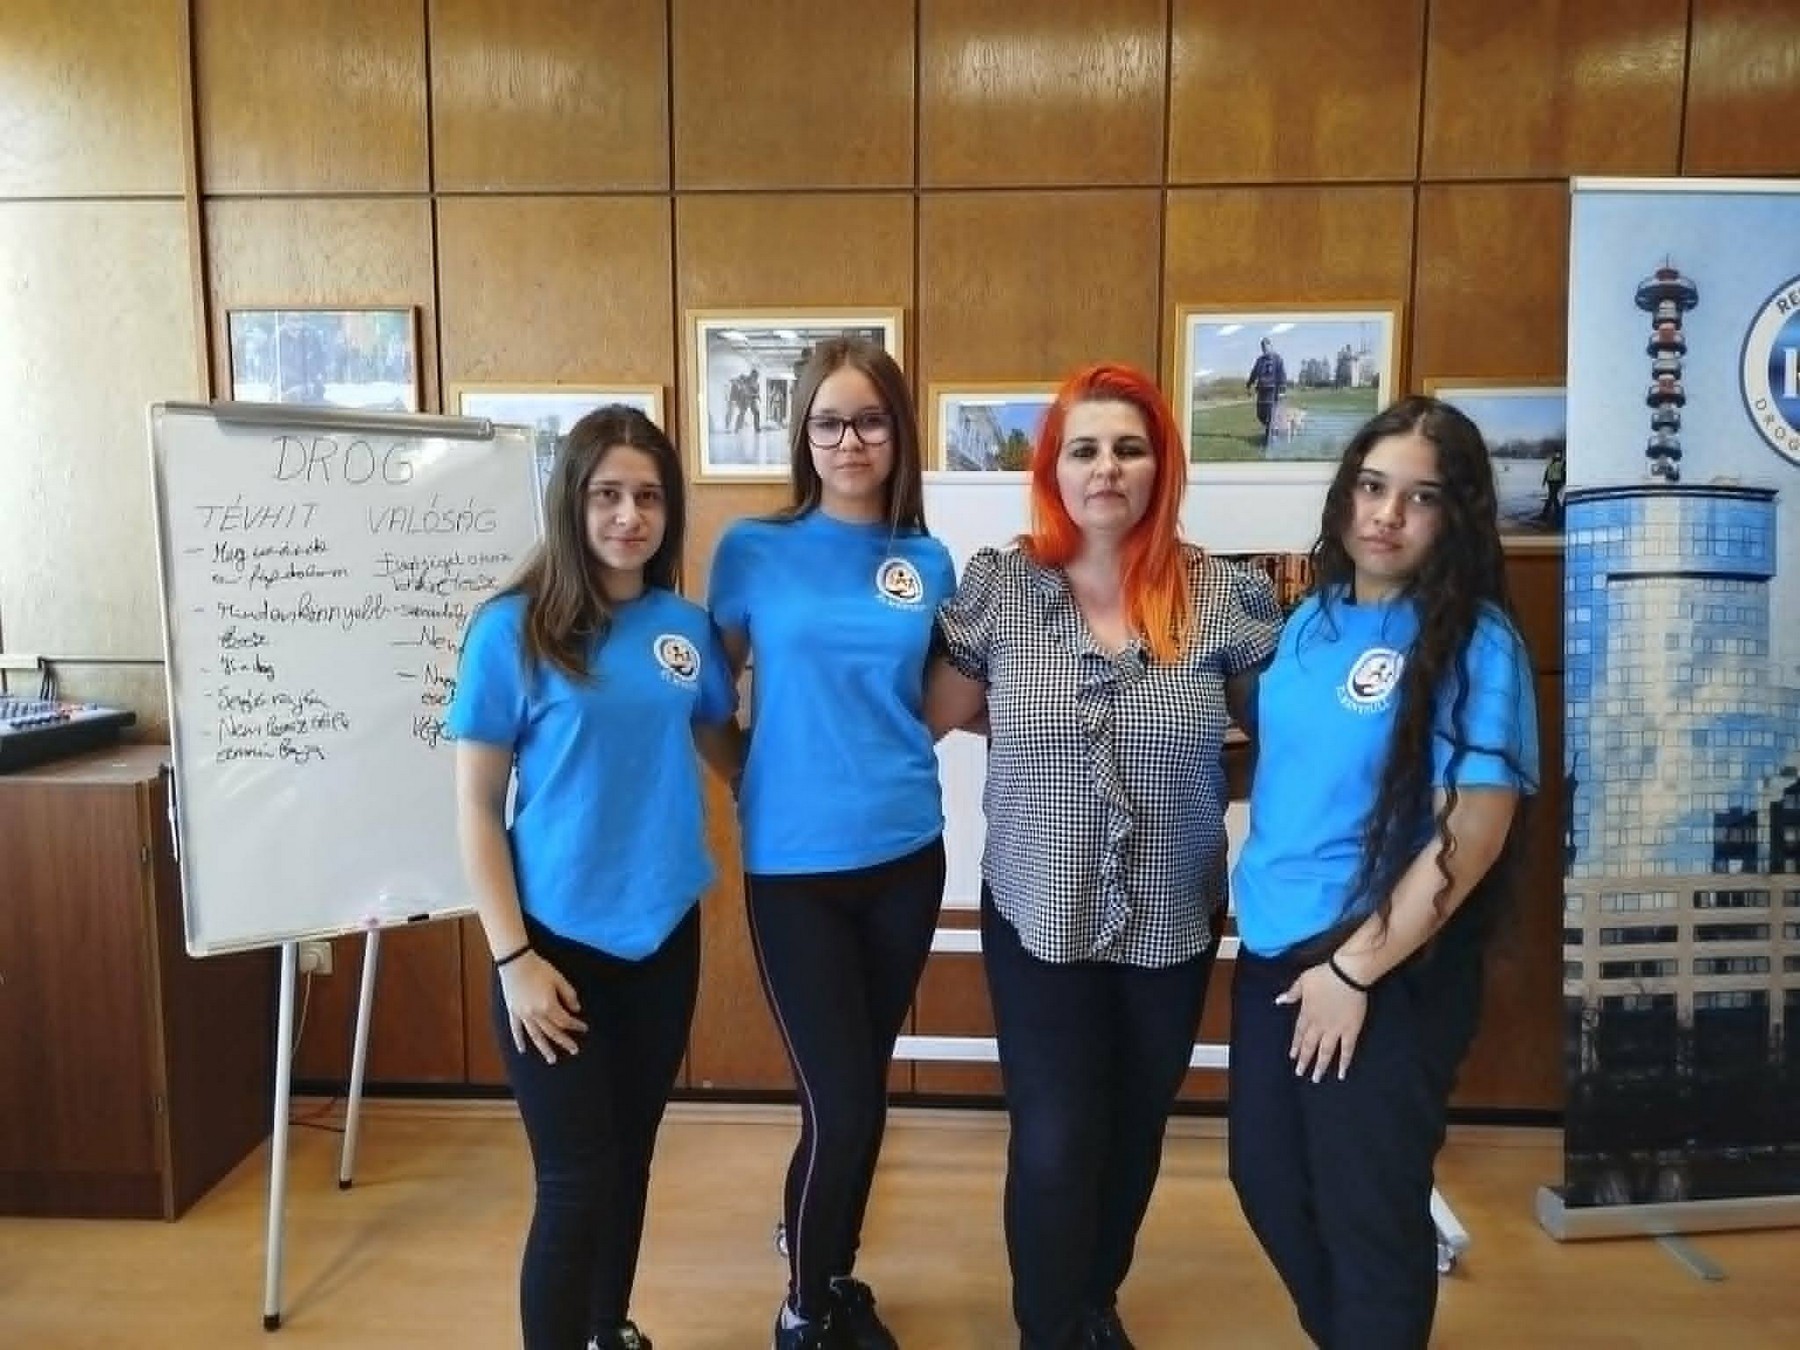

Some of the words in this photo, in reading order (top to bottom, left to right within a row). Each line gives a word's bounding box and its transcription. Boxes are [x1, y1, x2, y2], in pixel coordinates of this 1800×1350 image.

[272, 434, 414, 486] DROG
[196, 493, 319, 533] TÉVHIT
[366, 491, 498, 534] VALÓSÁG
